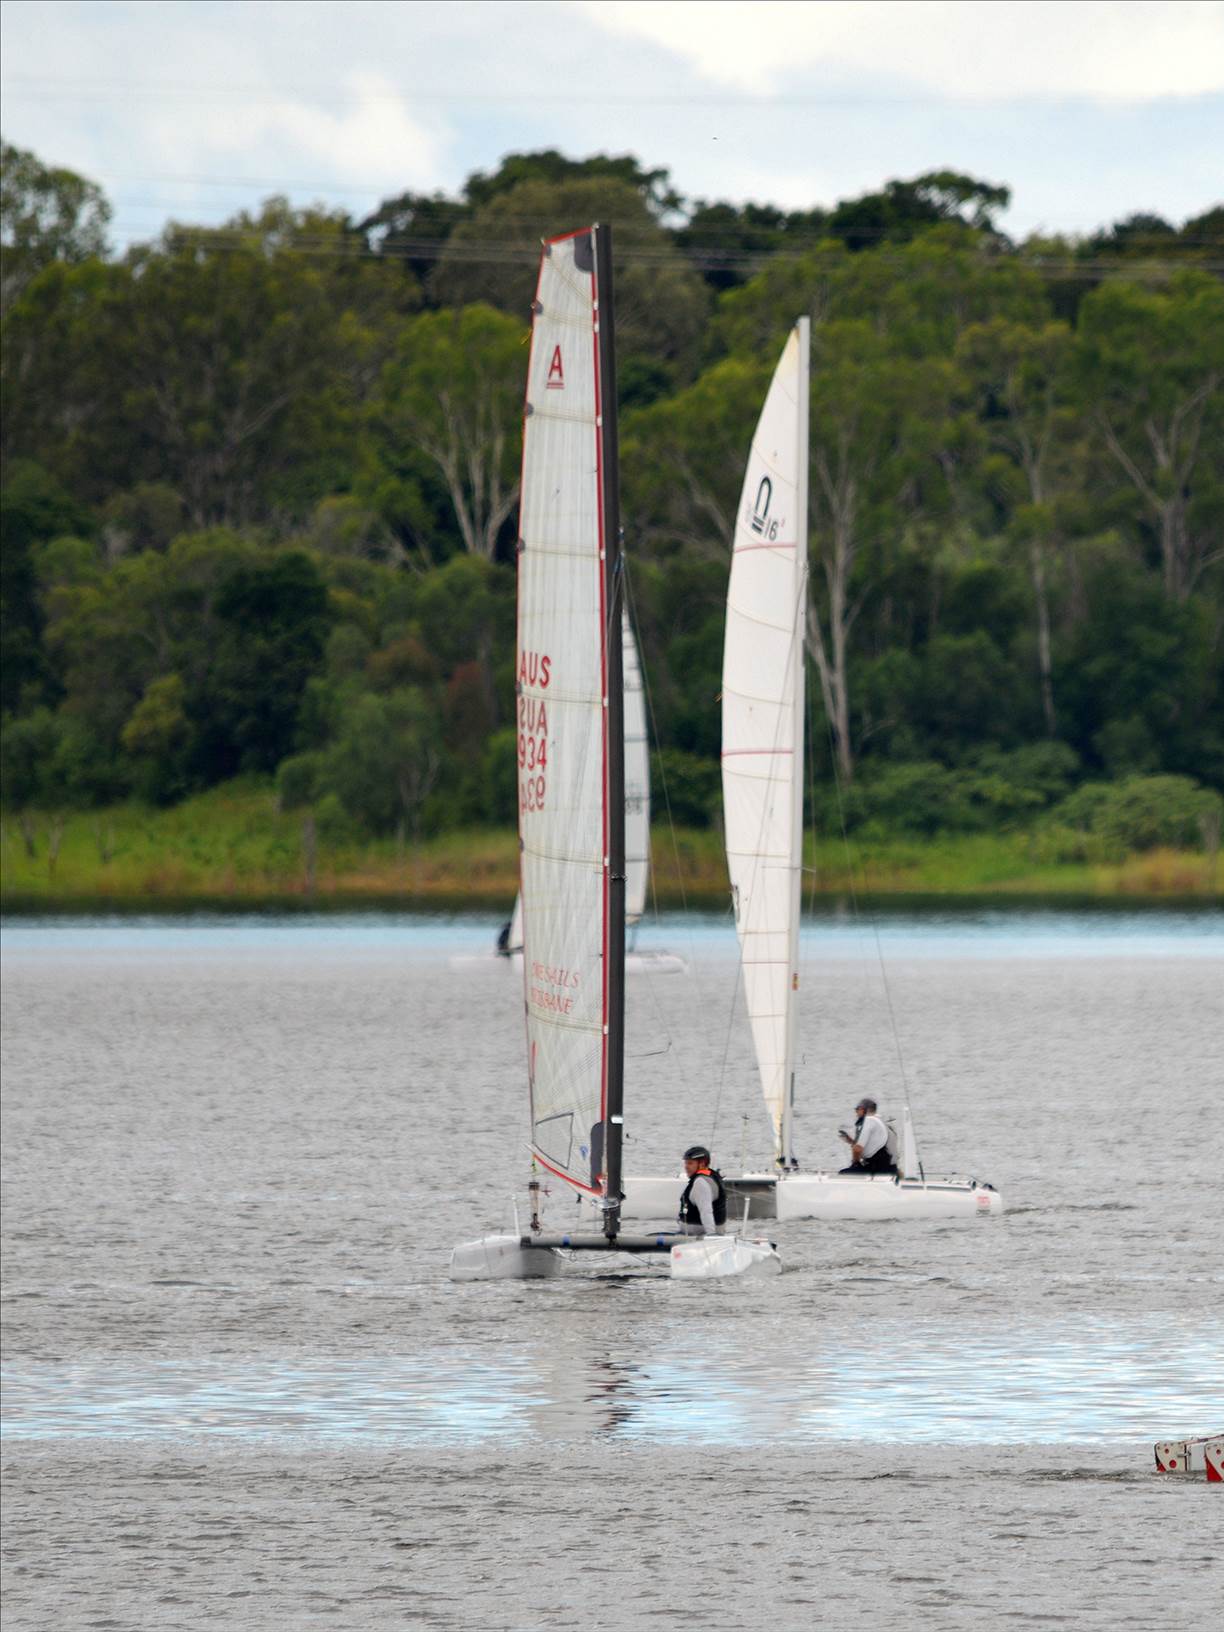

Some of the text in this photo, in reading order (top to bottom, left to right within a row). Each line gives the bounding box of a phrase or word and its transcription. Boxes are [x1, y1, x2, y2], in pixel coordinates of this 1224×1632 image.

[548, 344, 564, 379] A
[519, 650, 551, 688] AUS
[518, 734, 548, 772] 934
